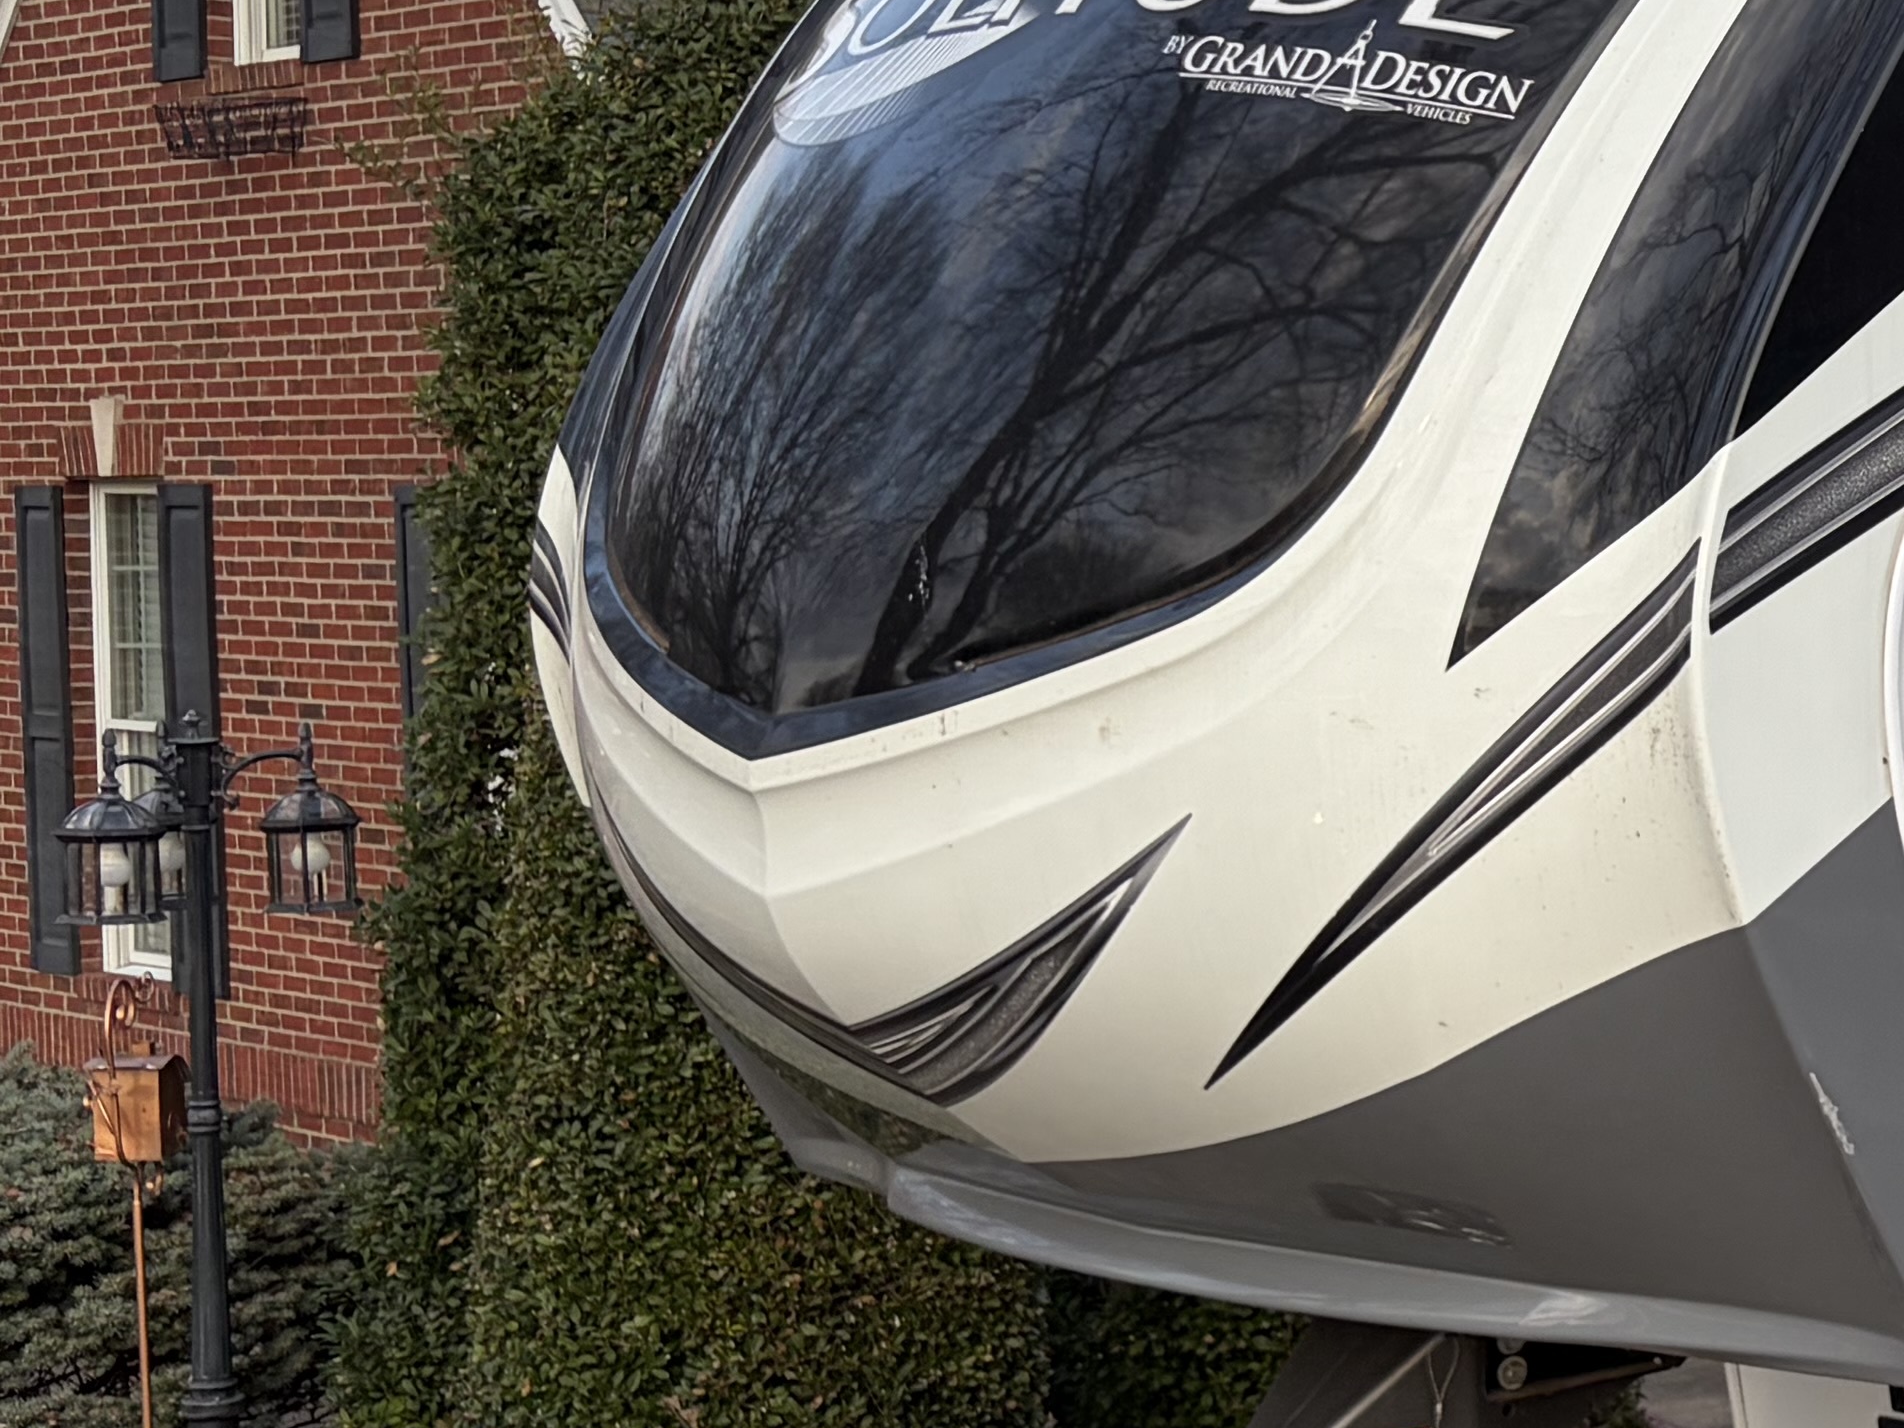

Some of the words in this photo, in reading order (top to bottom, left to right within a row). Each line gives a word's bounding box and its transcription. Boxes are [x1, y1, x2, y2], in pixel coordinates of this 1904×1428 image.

[1161, 34, 1194, 55] BY
[1183, 35, 1333, 82] GRAND
[1364, 50, 1534, 114] DESIGN
[1206, 80, 1297, 98] RECREATIONAL
[1406, 103, 1473, 125] VEHICLES
